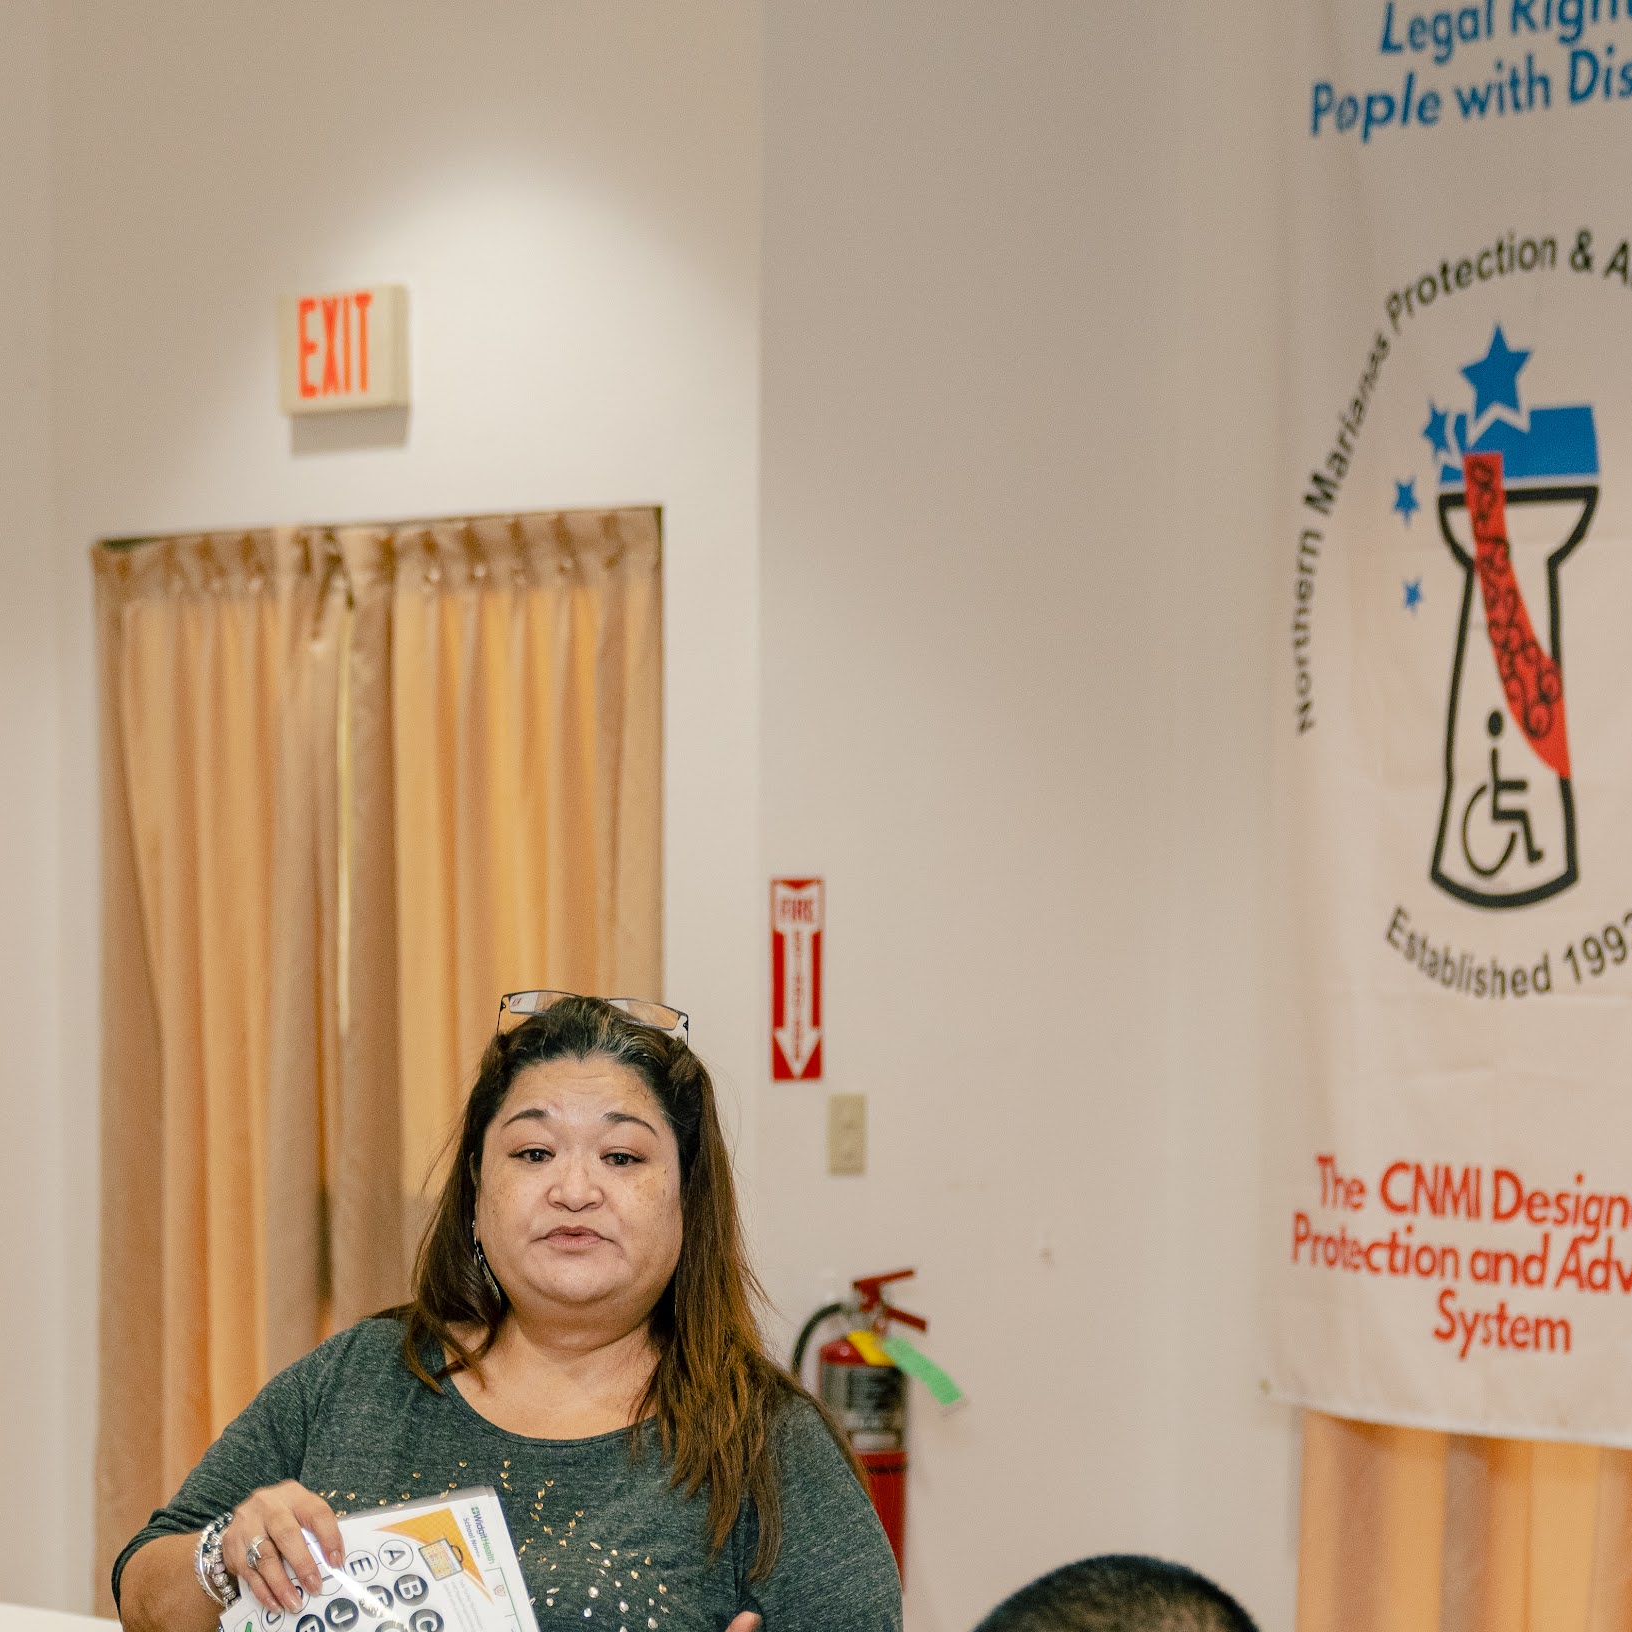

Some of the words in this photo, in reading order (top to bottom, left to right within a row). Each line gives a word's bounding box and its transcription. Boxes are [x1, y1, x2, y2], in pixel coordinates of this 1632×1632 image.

[1380, 0, 1495, 66] Legal
[1310, 72, 1442, 145] Pople
[1454, 54, 1553, 119] with
[1384, 232, 1558, 337] Protection
[1568, 229, 1595, 274] &
[296, 291, 374, 399] EXIT
[1384, 904, 1554, 1000] Established
[1315, 1152, 1367, 1213] The
[1378, 1160, 1483, 1223] CNMI
[1290, 1210, 1461, 1283] Protection
[1470, 1231, 1550, 1290] and
[1431, 1286, 1573, 1361] System
